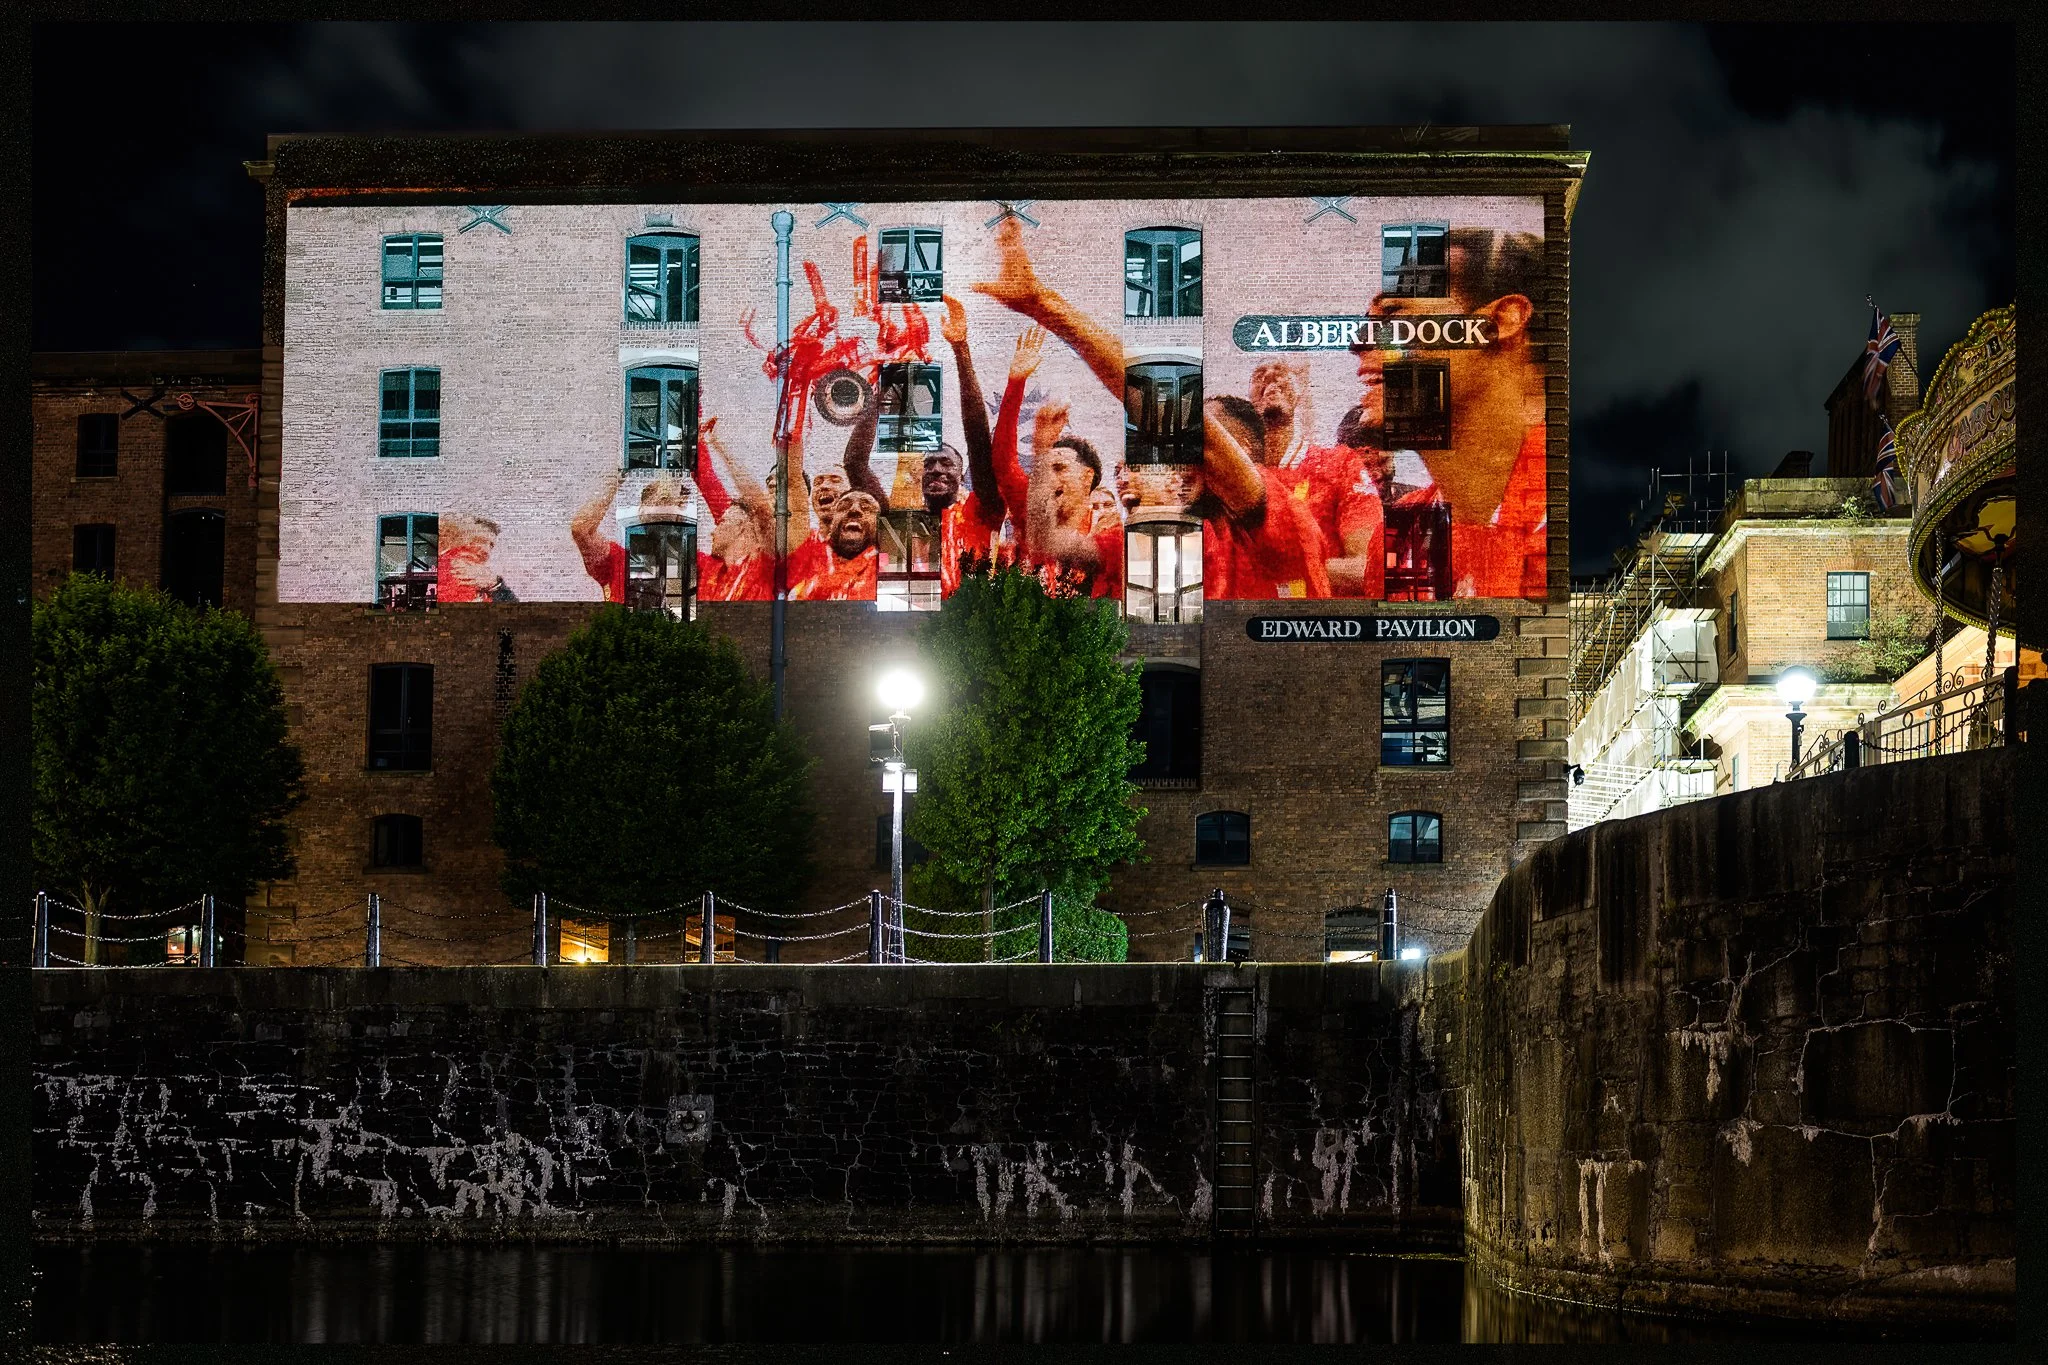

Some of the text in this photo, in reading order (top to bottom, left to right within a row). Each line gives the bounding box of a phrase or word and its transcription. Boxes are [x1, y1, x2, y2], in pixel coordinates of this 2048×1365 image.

[1251, 318, 1490, 347] ALBERT DOCK
[1260, 618, 1477, 639] EDWARD PAVILION
